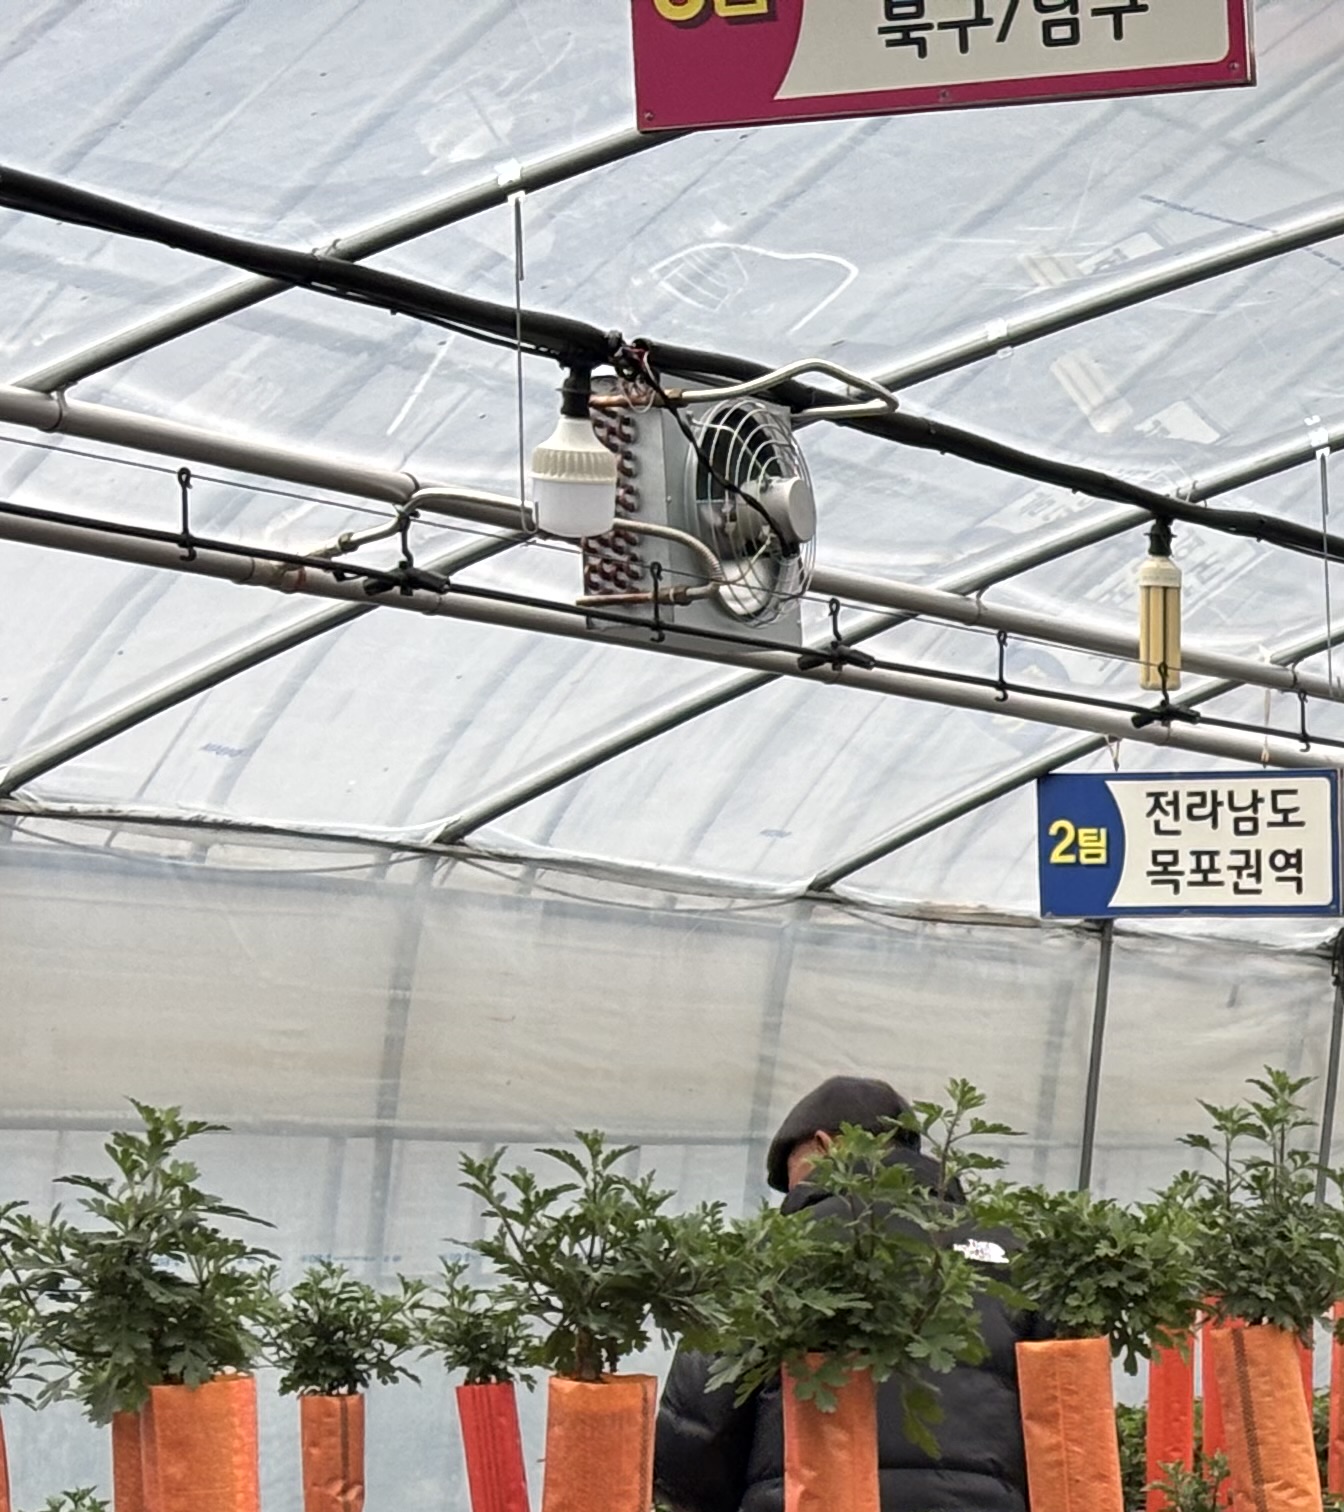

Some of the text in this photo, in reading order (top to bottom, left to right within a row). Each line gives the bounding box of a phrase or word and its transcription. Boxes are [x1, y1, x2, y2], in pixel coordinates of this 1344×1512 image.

[1145, 788, 1306, 836] 전라남도
[1048, 819, 1108, 865] 2팀
[1146, 848, 1305, 896] 목포권역
